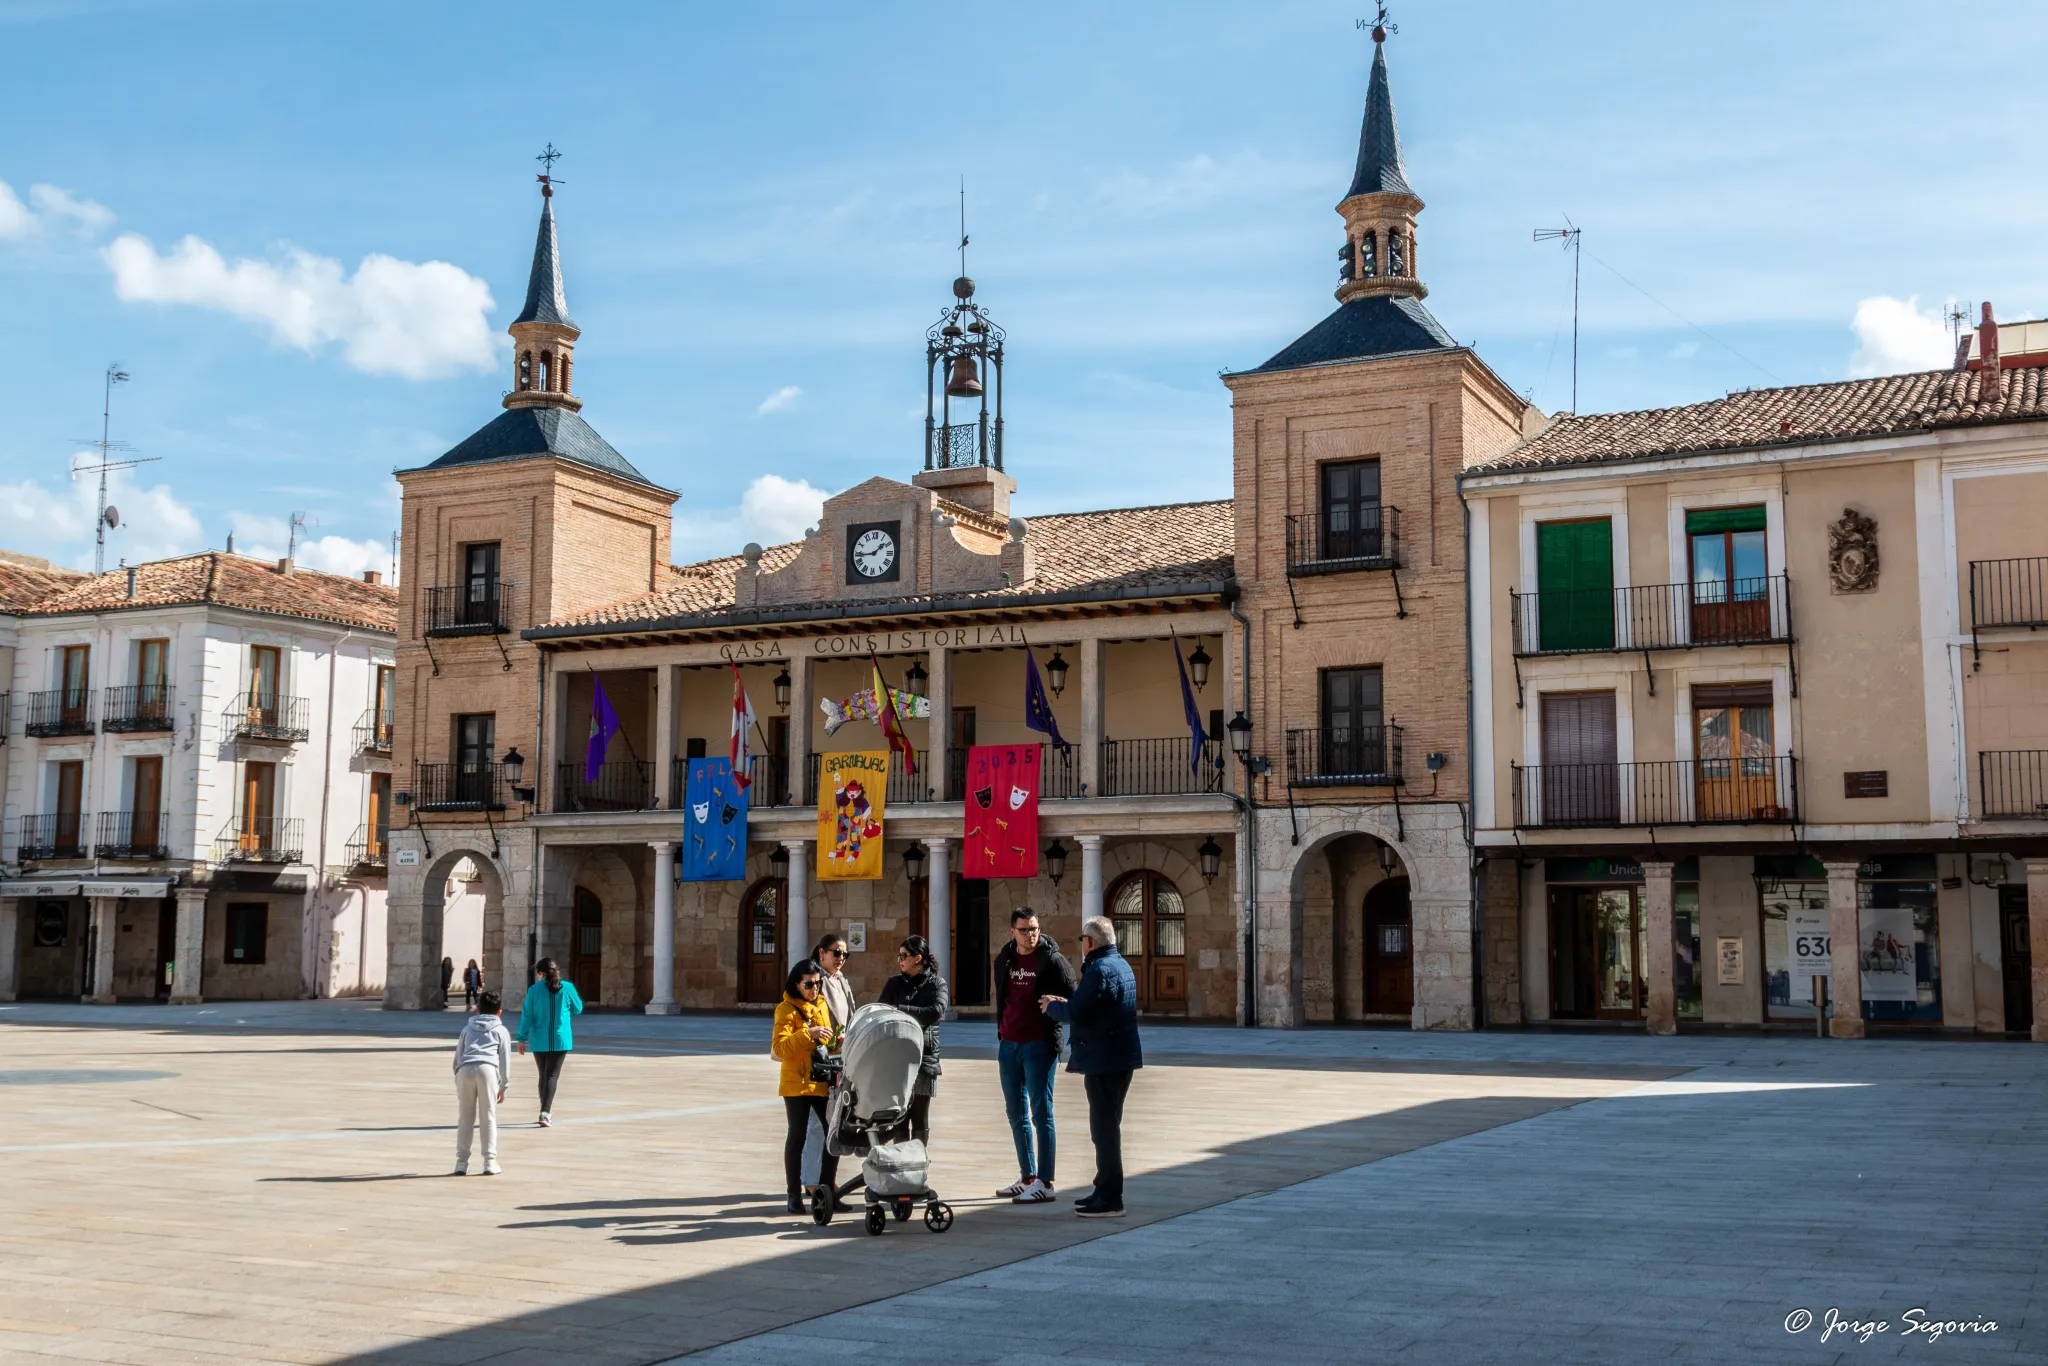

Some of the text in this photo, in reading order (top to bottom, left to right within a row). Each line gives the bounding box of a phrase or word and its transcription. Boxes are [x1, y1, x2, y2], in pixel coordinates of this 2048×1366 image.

[720, 625, 1021, 660] CASA CONSISTORIAL
[977, 749, 1033, 774] 2025
[1609, 864, 1645, 875] Unica
